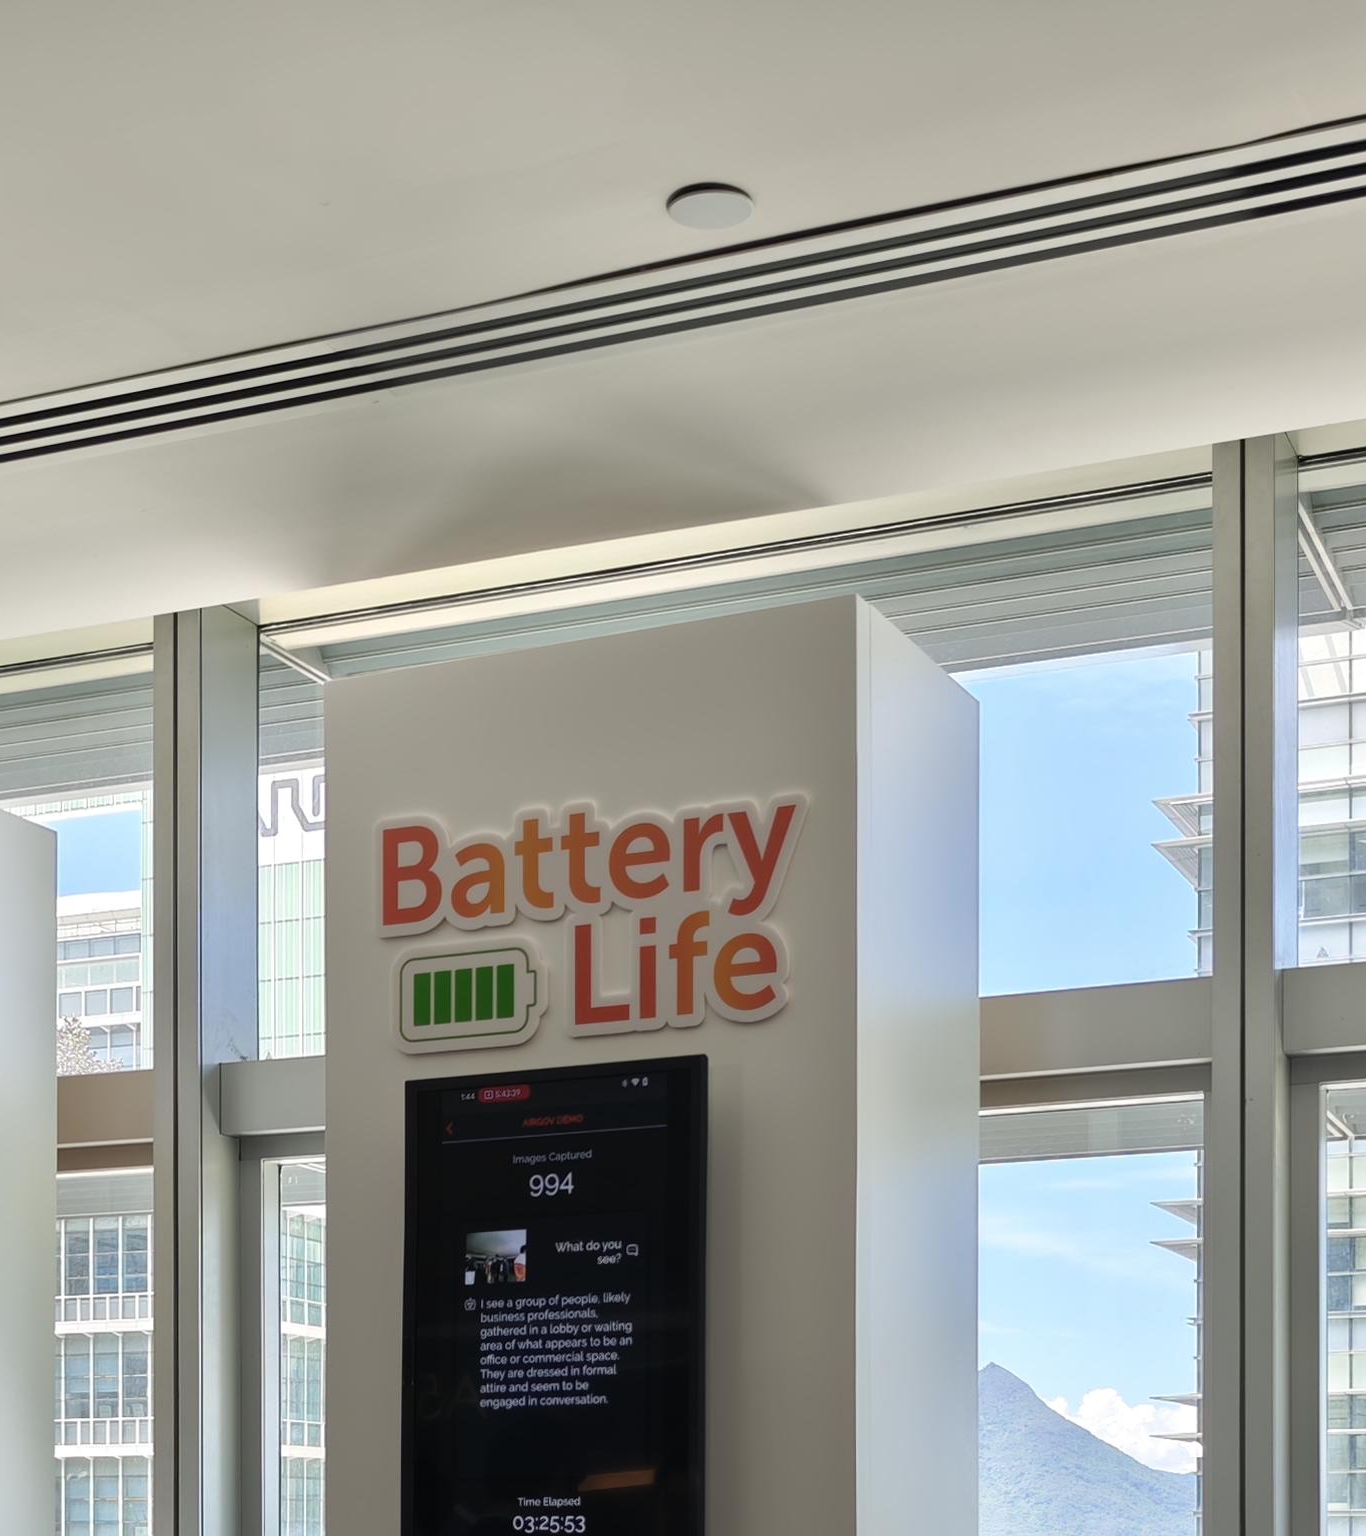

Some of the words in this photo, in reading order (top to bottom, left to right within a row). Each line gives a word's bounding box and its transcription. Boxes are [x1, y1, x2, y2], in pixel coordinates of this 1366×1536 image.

[382, 804, 796, 926] Battery
[574, 910, 778, 1025] Life
[513, 1153, 546, 1165] Images
[549, 1149, 592, 1163] Captured
[529, 1172, 574, 1197] 994
[555, 1241, 584, 1252] What
[586, 1241, 600, 1251] do
[602, 1240, 622, 1253] you
[597, 1253, 622, 1265] see?
[481, 1299, 484, 1309] I
[486, 1299, 504, 1309] see
[506, 1299, 513, 1308] a
[515, 1298, 546, 1310] group
[548, 1294, 559, 1307] of
[603, 1292, 631, 1305] likely
[480, 1311, 525, 1323] business
[480, 1326, 527, 1340] gathered
[529, 1325, 539, 1335] in
[540, 1325, 548, 1334] a
[549, 1323, 579, 1335] lobby
[581, 1324, 592, 1333] or
[594, 1321, 633, 1334] waiting
[480, 1341, 503, 1351] area
[505, 1339, 516, 1350] of
[518, 1339, 543, 1350] what
[545, 1337, 587, 1351] appears
[590, 1337, 601, 1347] to
[603, 1335, 617, 1346] be
[619, 1336, 633, 1346] an
[480, 1354, 507, 1365] office
[509, 1354, 521, 1364] or
[522, 1351, 584, 1363] commercial
[586, 1351, 620, 1363] space.
[480, 1368, 505, 1381] They
[507, 1369, 524, 1378] are
[526, 1366, 568, 1378] dressed
[570, 1366, 580, 1376] in
[582, 1364, 617, 1376] formal
[480, 1383, 507, 1394] attire
[508, 1382, 529, 1392] and
[531, 1381, 560, 1392] seem
[562, 1381, 573, 1391] to
[575, 1380, 589, 1390] be
[480, 1396, 526, 1409] engaged
[528, 1395, 537, 1406] in
[539, 1393, 608, 1405] conversation.
[517, 1497, 541, 1507] Time
[543, 1496, 581, 1509] Elapsed
[513, 1515, 586, 1533] 03:25:53
